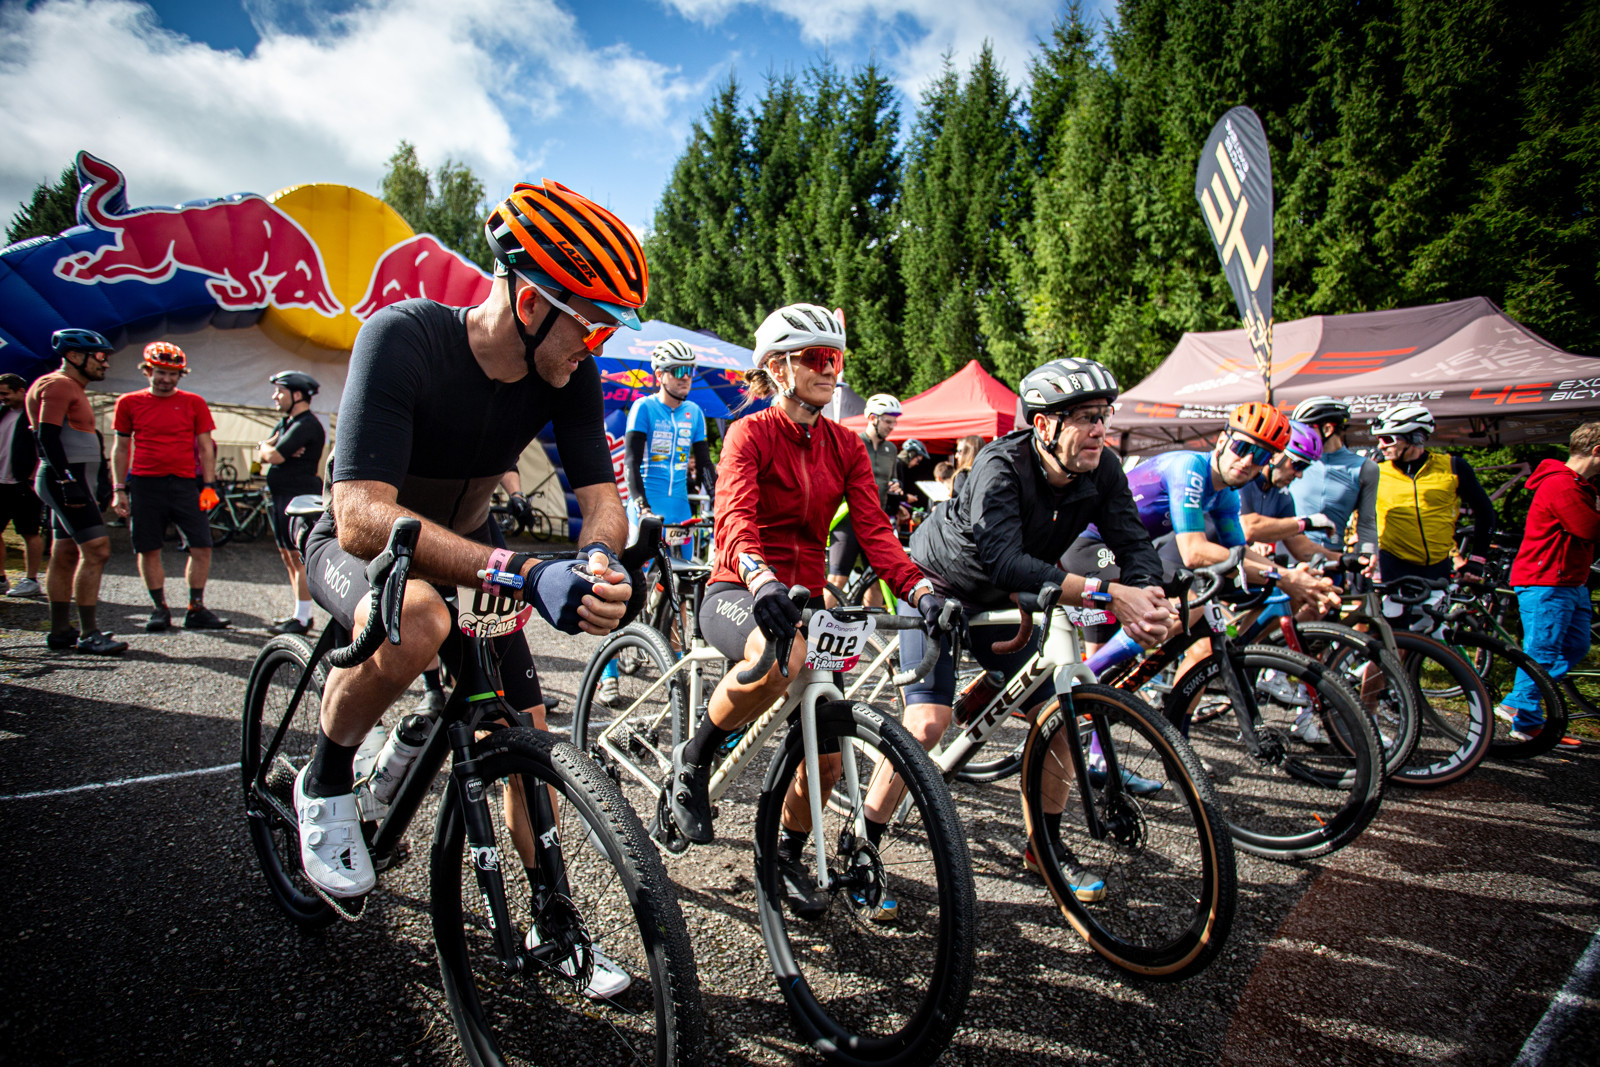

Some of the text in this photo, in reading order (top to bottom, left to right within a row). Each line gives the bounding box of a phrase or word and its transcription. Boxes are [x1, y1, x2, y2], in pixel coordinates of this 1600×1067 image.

[557, 241, 597, 281] LAZER
[1067, 373, 1081, 390] POC
[1469, 382, 1553, 405] 4E
[1342, 389, 1444, 405] EXCLUSIVE
[1134, 402, 1183, 419] 4E
[1184, 469, 1204, 509] kilpi
[715, 598, 750, 627] velocio
[816, 632, 858, 657] 012
[1182, 663, 1220, 697] DT SWISS
[964, 656, 1047, 742] TREK
[539, 825, 560, 849] FO
[470, 846, 500, 871] FOX
